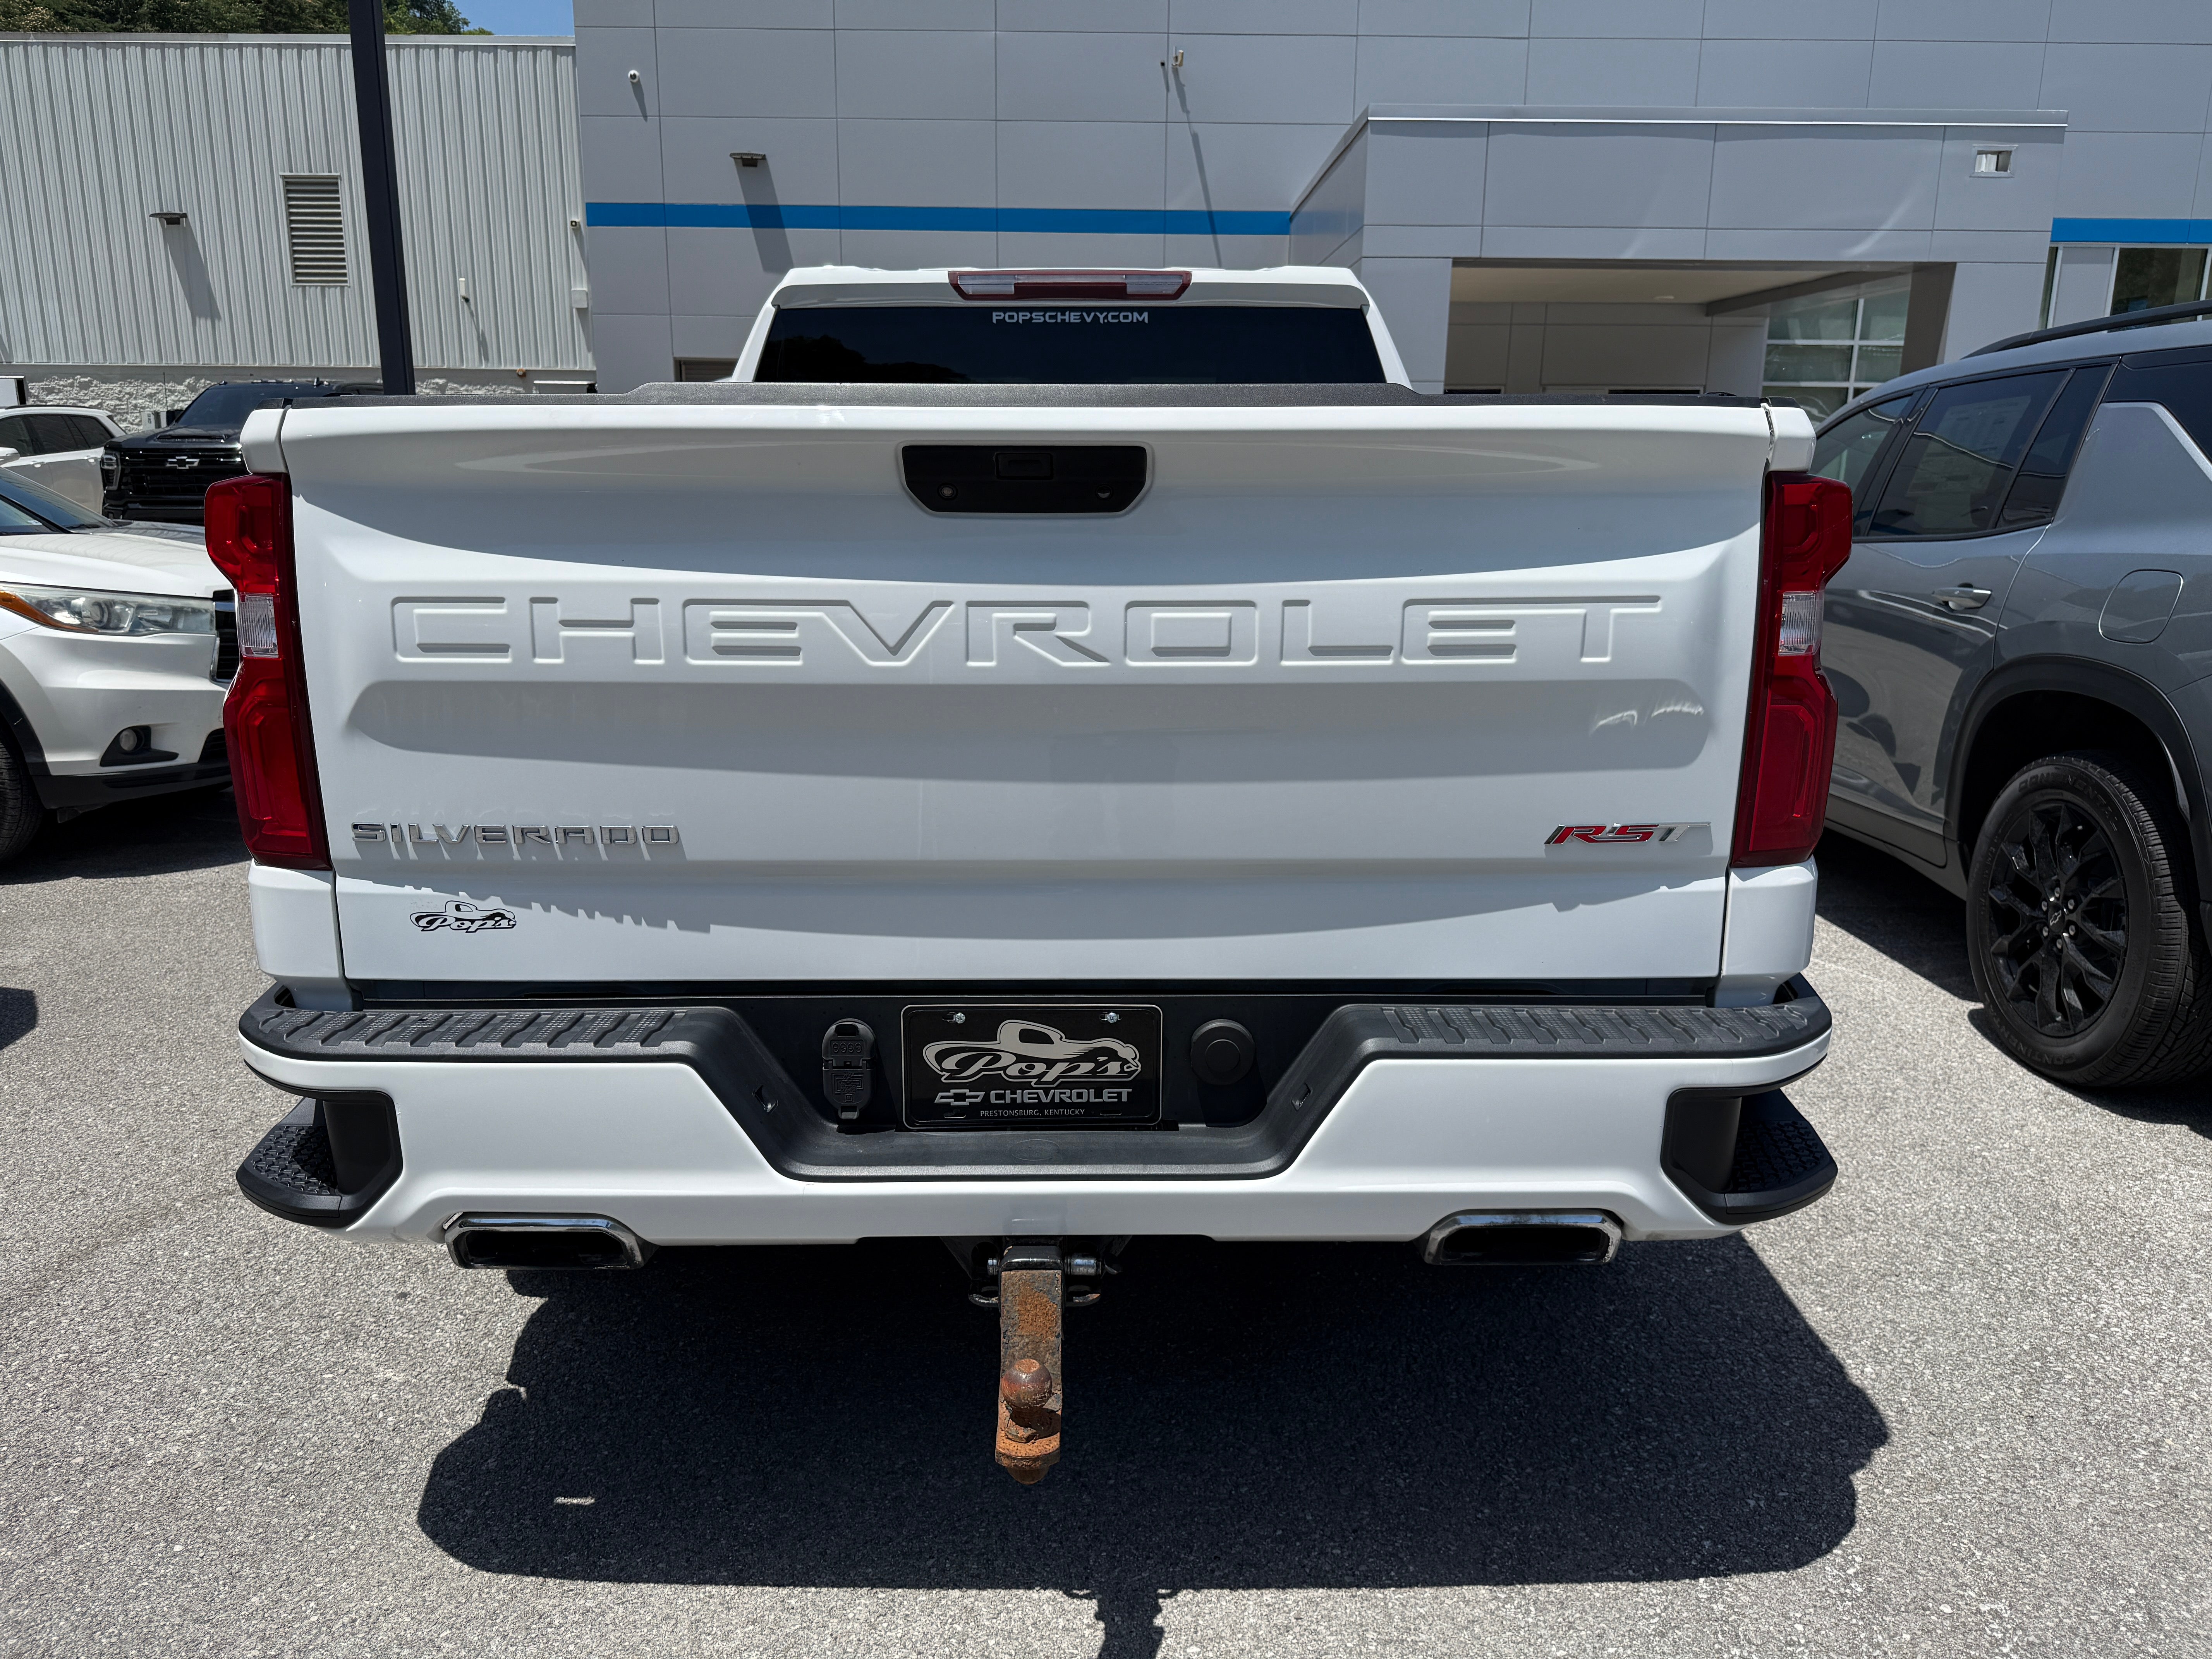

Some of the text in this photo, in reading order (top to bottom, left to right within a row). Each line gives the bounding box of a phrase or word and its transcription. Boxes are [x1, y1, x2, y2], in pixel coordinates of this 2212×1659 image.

[992, 311, 1149, 324] POPSCHEVY.COM
[391, 595, 1662, 667] CHEVROLET
[351, 822, 679, 845] SILVERADO
[1544, 822, 1711, 845] RST
[941, 1052, 1128, 1082] Pop's
[990, 1089, 1132, 1104] CHEVROLET
